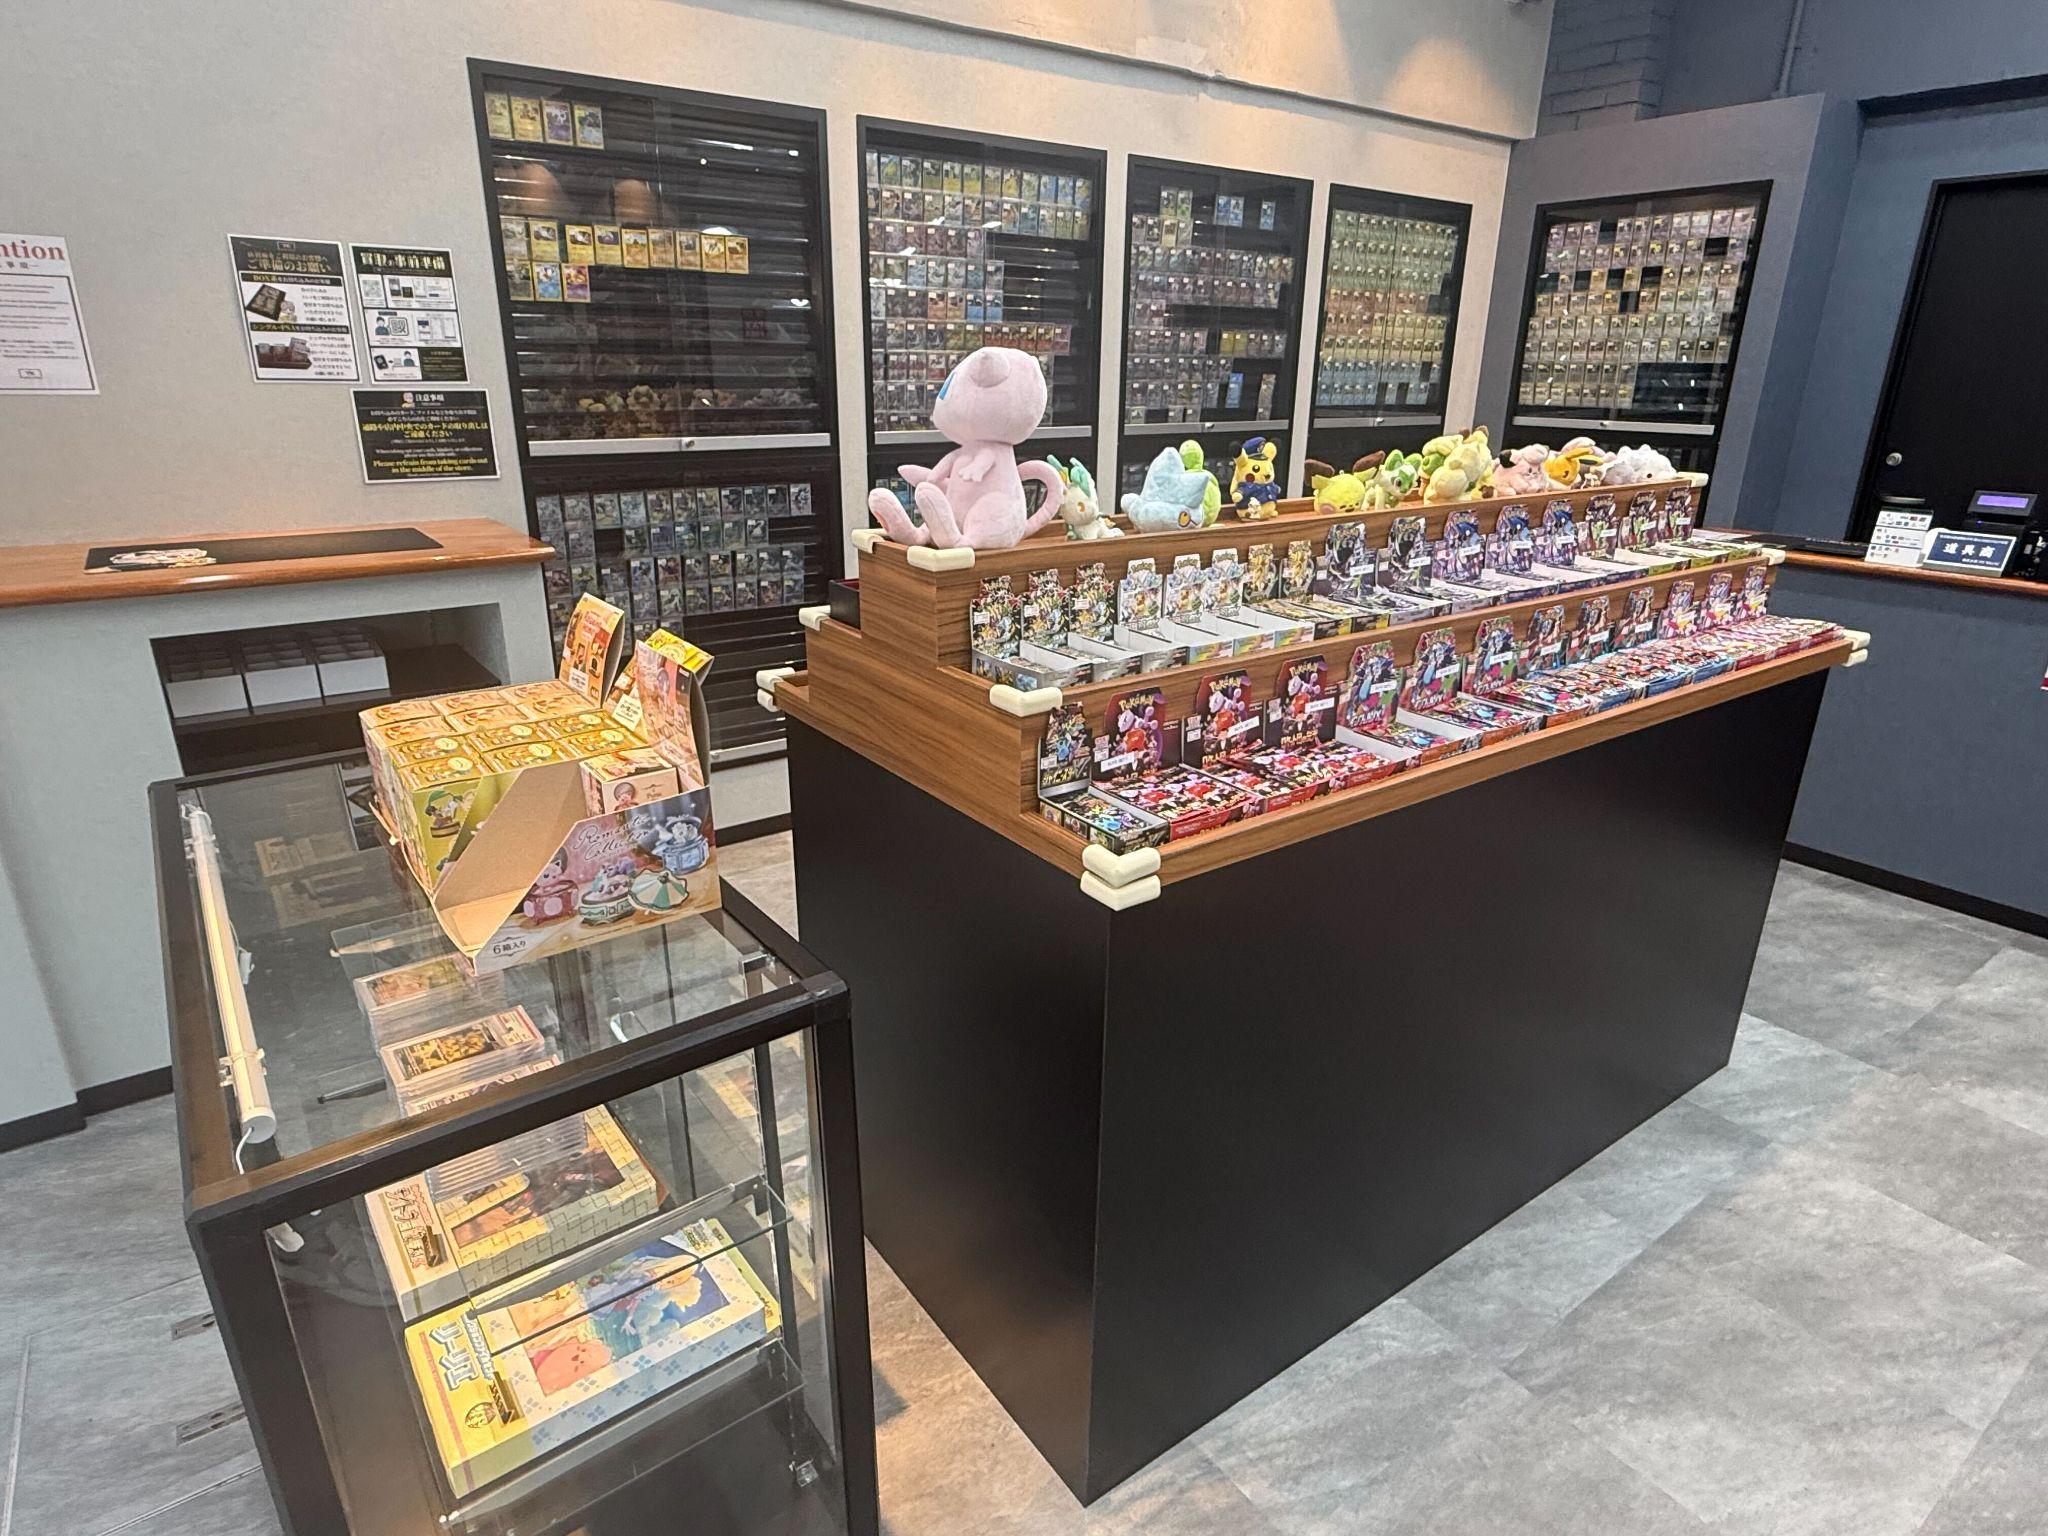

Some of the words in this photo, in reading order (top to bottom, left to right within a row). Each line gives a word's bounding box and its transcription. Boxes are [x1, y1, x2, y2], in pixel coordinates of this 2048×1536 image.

[1118, 694, 1155, 711] Pokémon
[493, 940, 526, 955] 6箱入り
[429, 1320, 480, 1391] リーリエ
